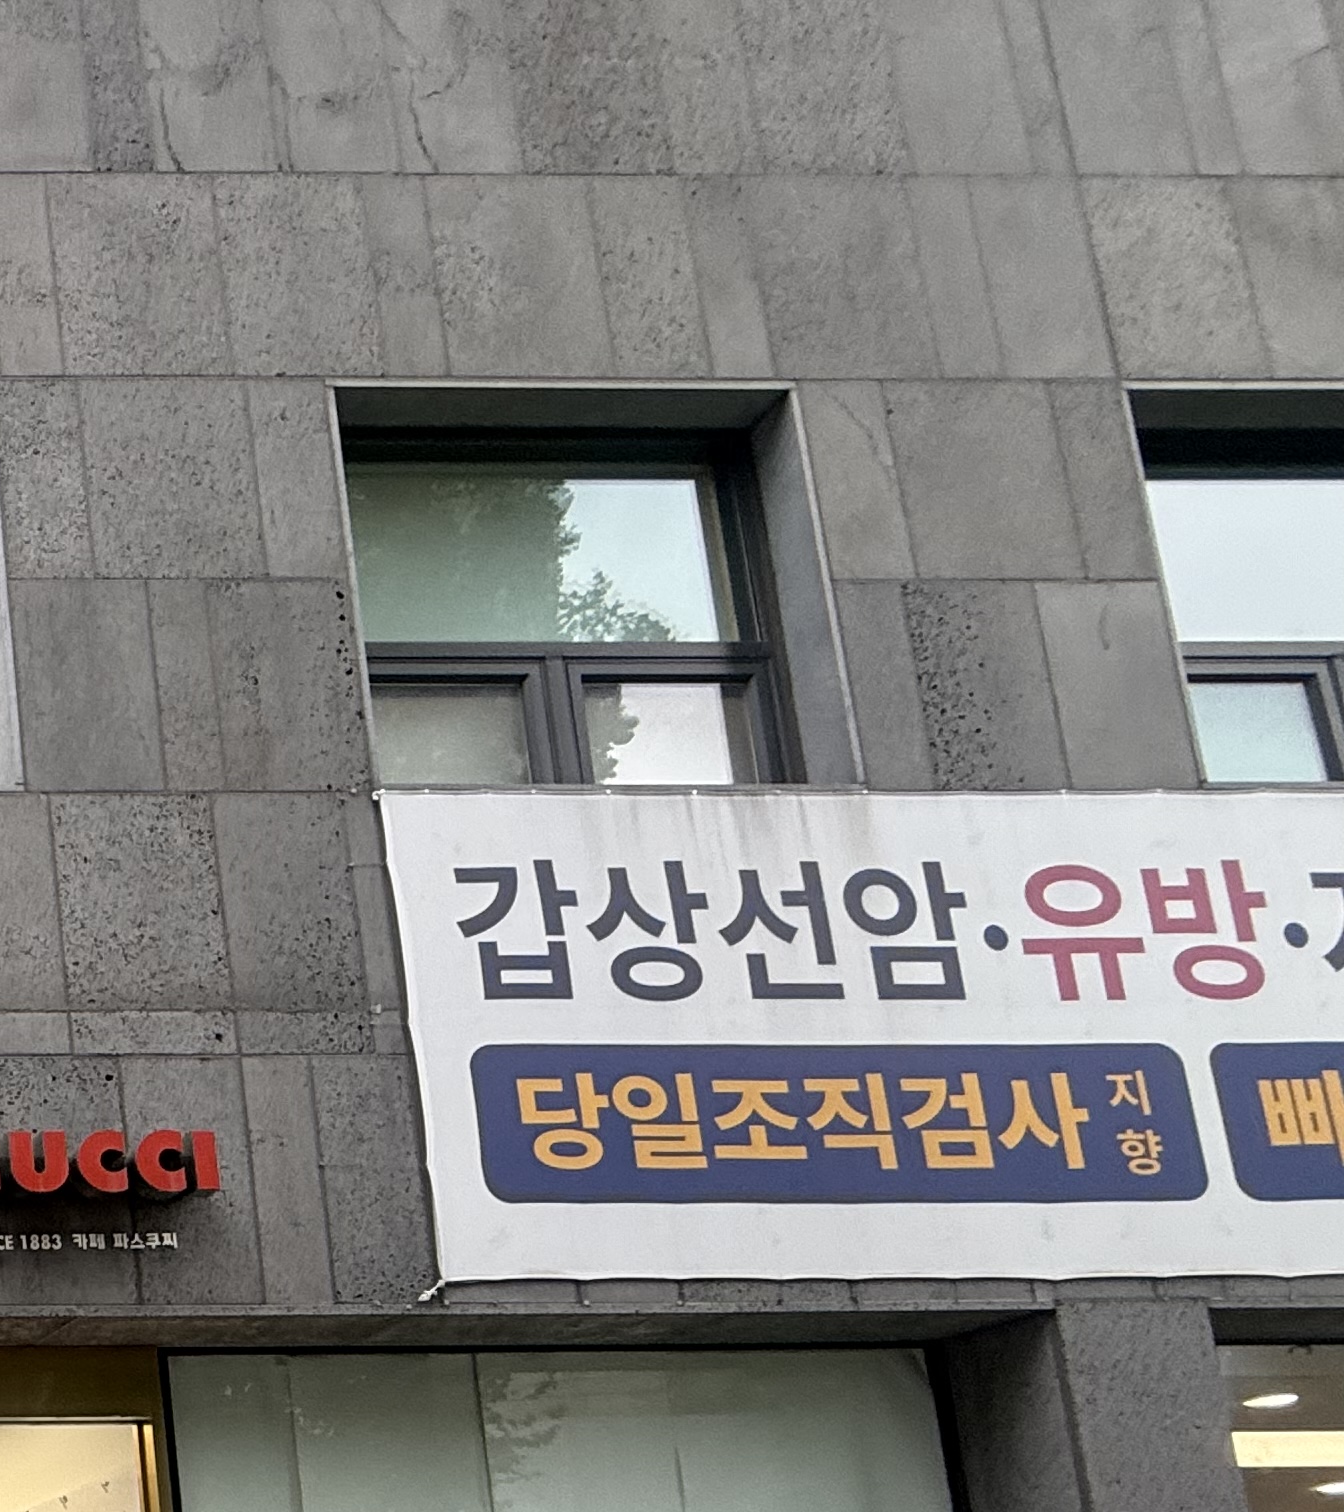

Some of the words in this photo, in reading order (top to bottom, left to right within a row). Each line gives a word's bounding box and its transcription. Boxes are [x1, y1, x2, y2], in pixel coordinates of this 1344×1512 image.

[515, 1071, 1089, 1171] 당일조직검사
[1105, 1070, 1163, 1176] 지향
[20, 1234, 62, 1250] 1883
[72, 1233, 106, 1250] 카페
